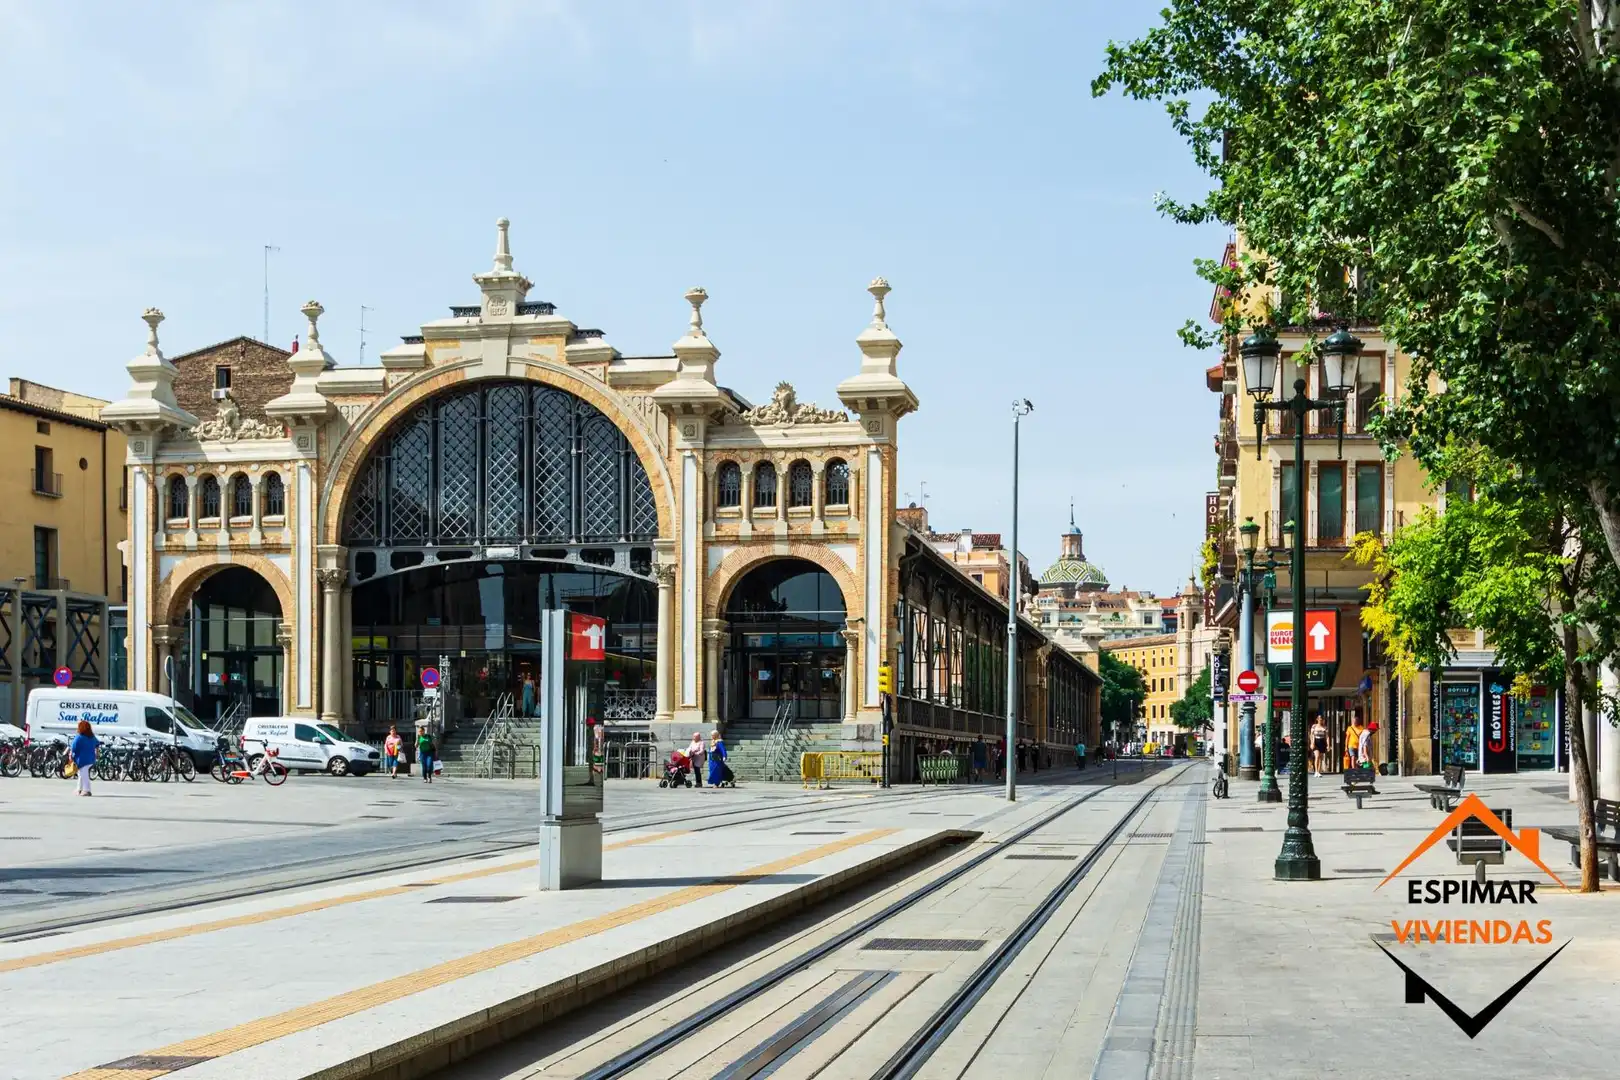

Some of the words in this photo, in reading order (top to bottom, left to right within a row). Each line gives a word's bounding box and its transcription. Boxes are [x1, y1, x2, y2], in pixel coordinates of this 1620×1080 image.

[59, 701, 118, 710] CRISTALERIA
[58, 711, 78, 721] San
[81, 712, 118, 724] Rafael
[1490, 694, 1501, 740] MÓVILES
